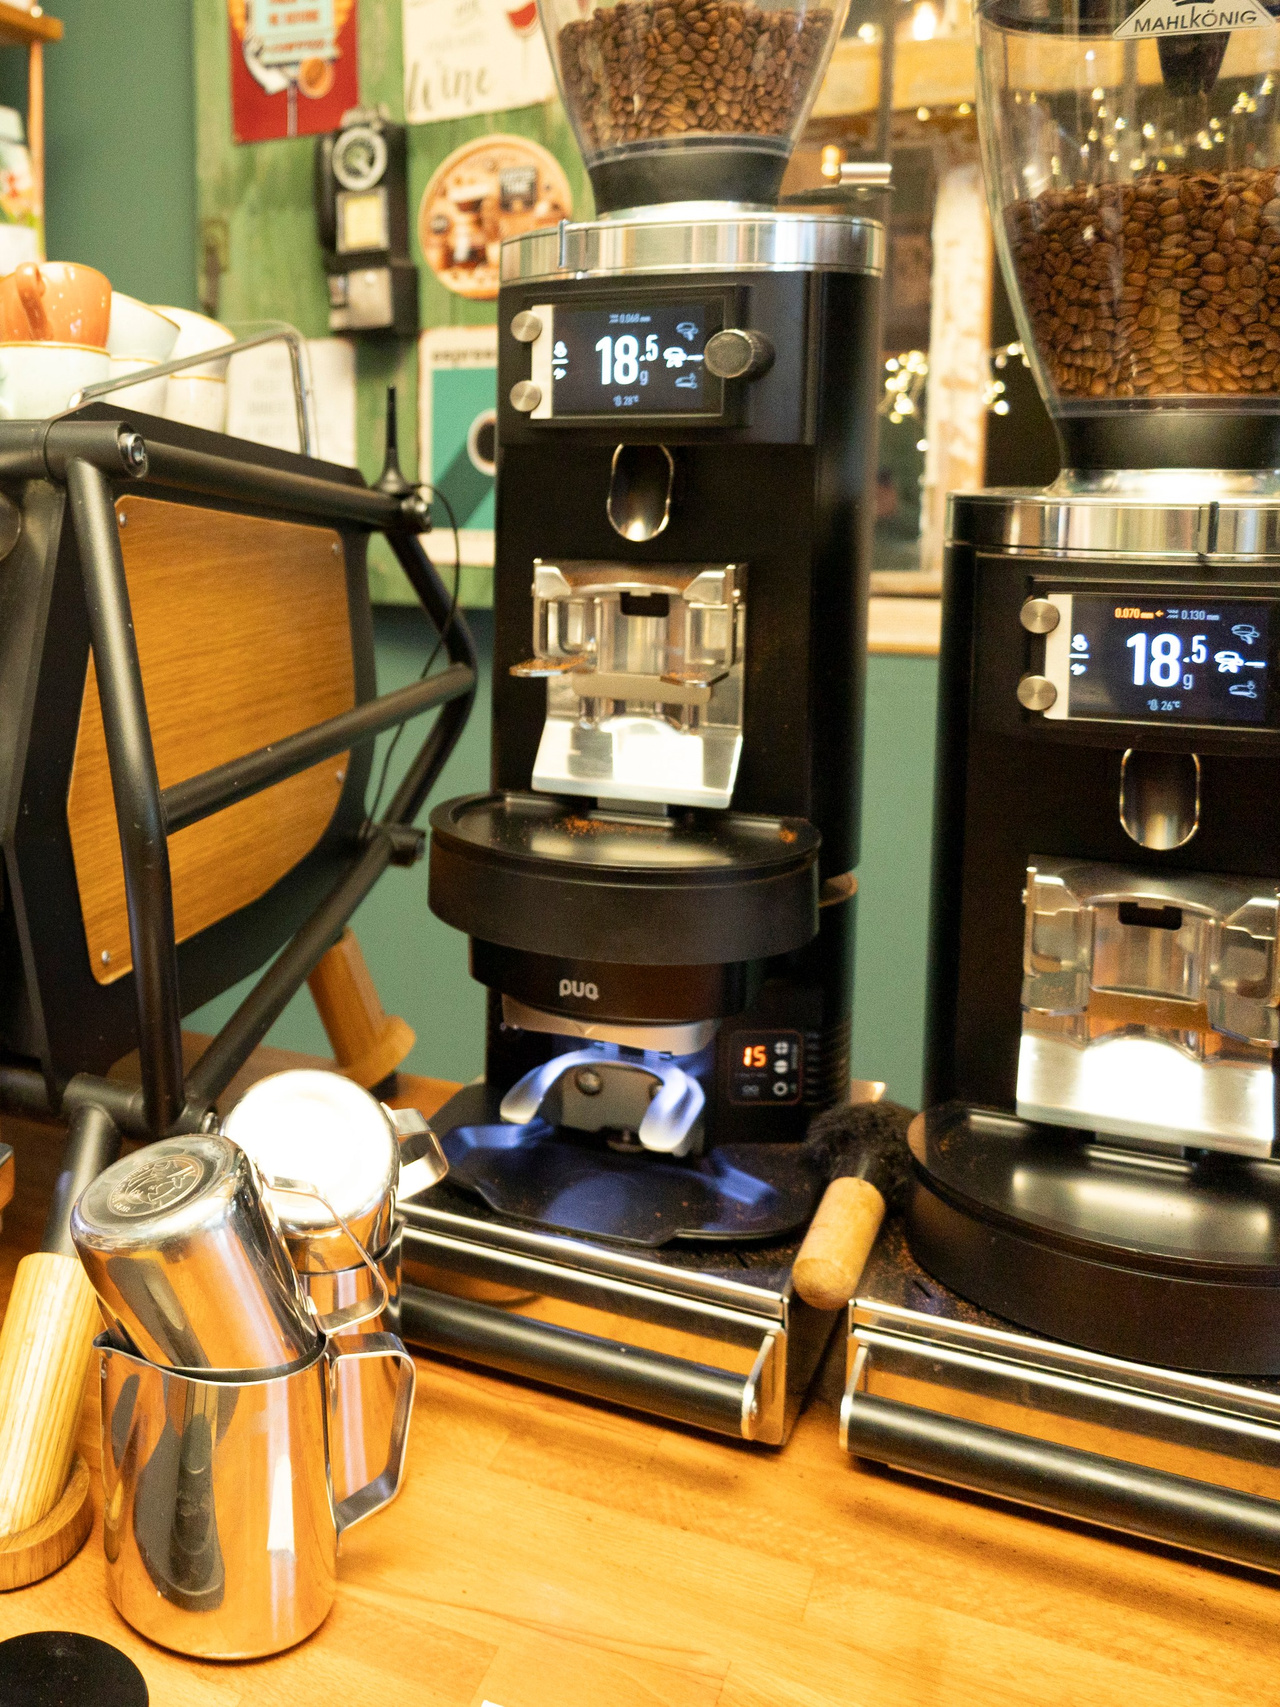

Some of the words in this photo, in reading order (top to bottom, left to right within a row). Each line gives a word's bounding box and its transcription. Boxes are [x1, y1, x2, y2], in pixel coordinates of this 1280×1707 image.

[595, 334, 659, 386] 18.5
[1114, 607, 1140, 619] 0.070
[1181, 610, 1206, 621] 0.130
[1126, 632, 1208, 688] 18.5
[1182, 673, 1194, 691] g
[742, 1044, 768, 1068] 15
